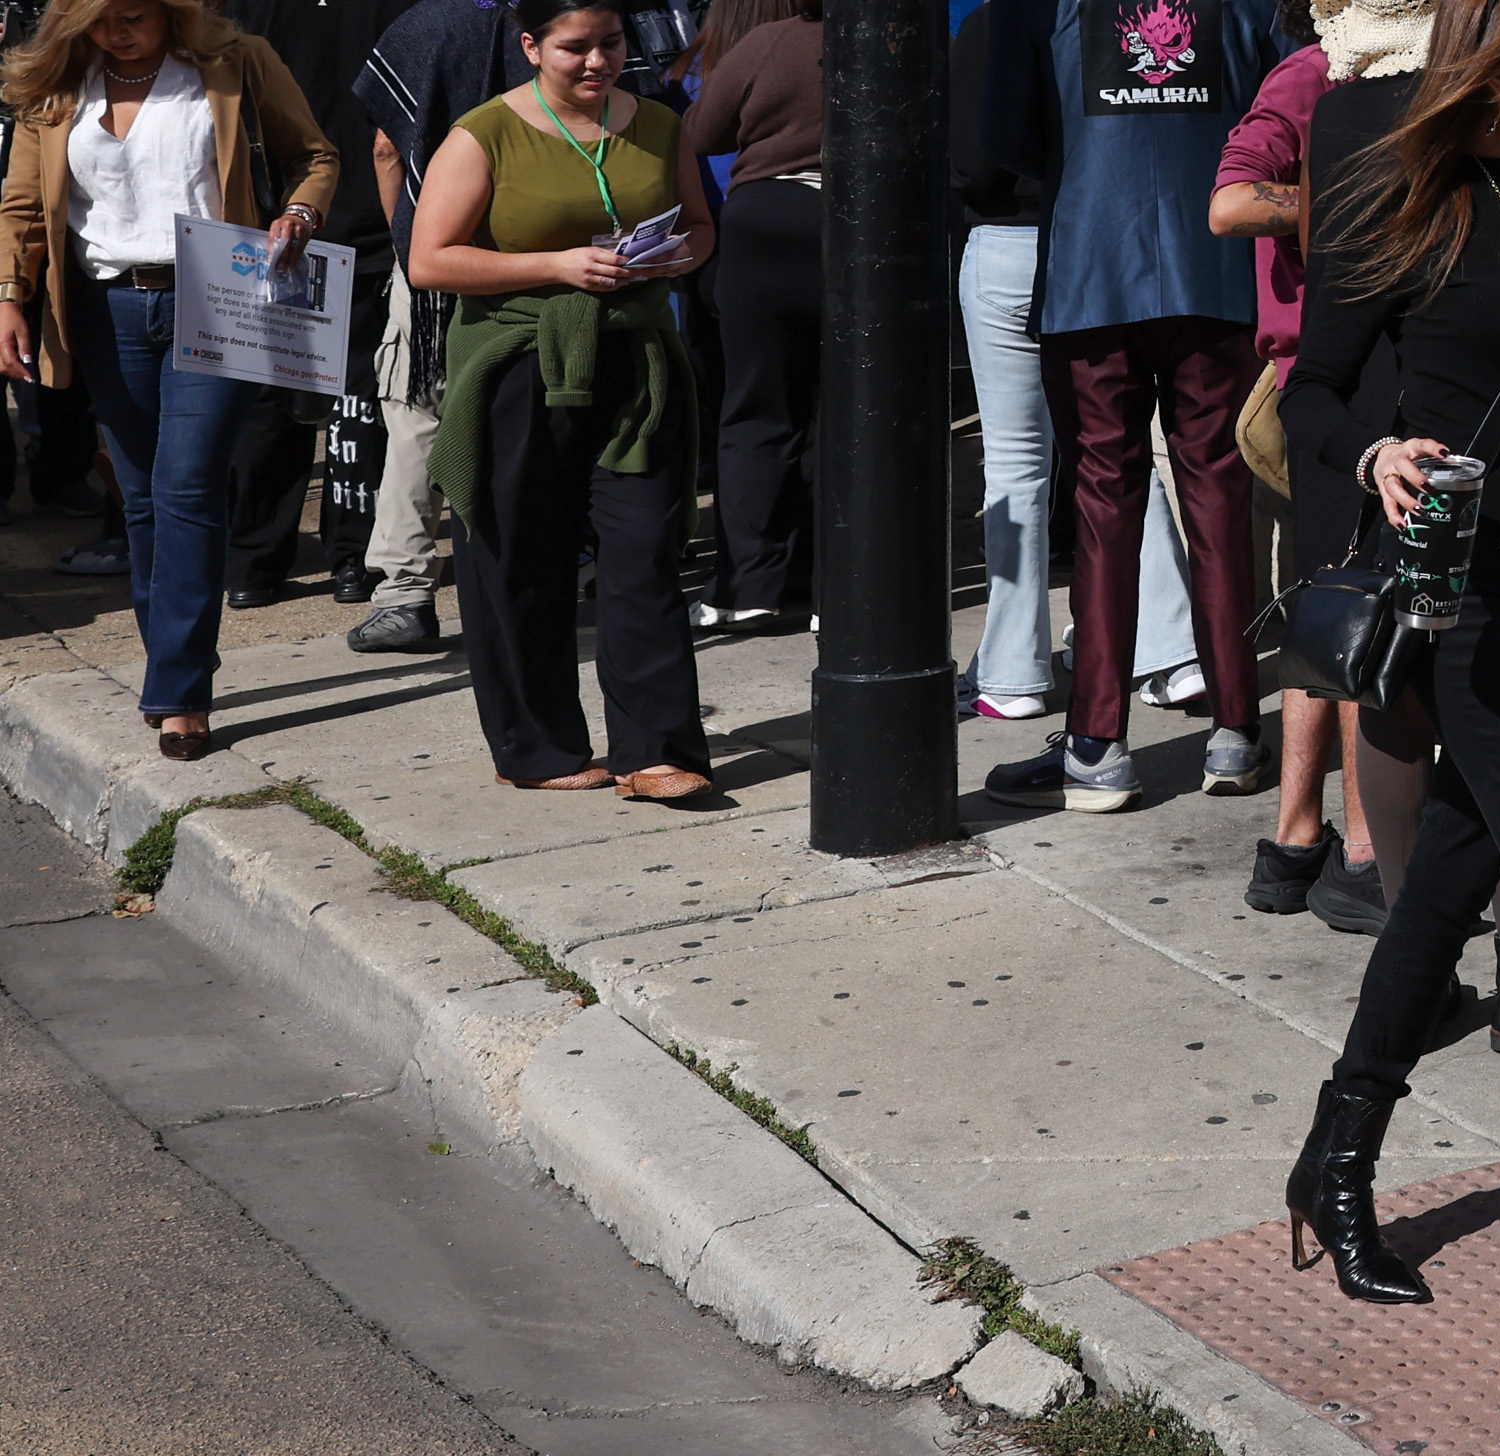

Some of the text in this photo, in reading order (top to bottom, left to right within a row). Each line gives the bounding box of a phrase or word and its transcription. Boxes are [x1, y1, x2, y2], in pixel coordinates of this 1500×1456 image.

[1099, 87, 1209, 105] SAMURAI
[222, 286, 246, 298] person
[236, 321, 268, 336] displaying
[198, 331, 328, 363] This sign does not constitute legal advice.
[200, 349, 224, 362] CHICAGO
[274, 364, 339, 384] Chicago.gov/Protect
